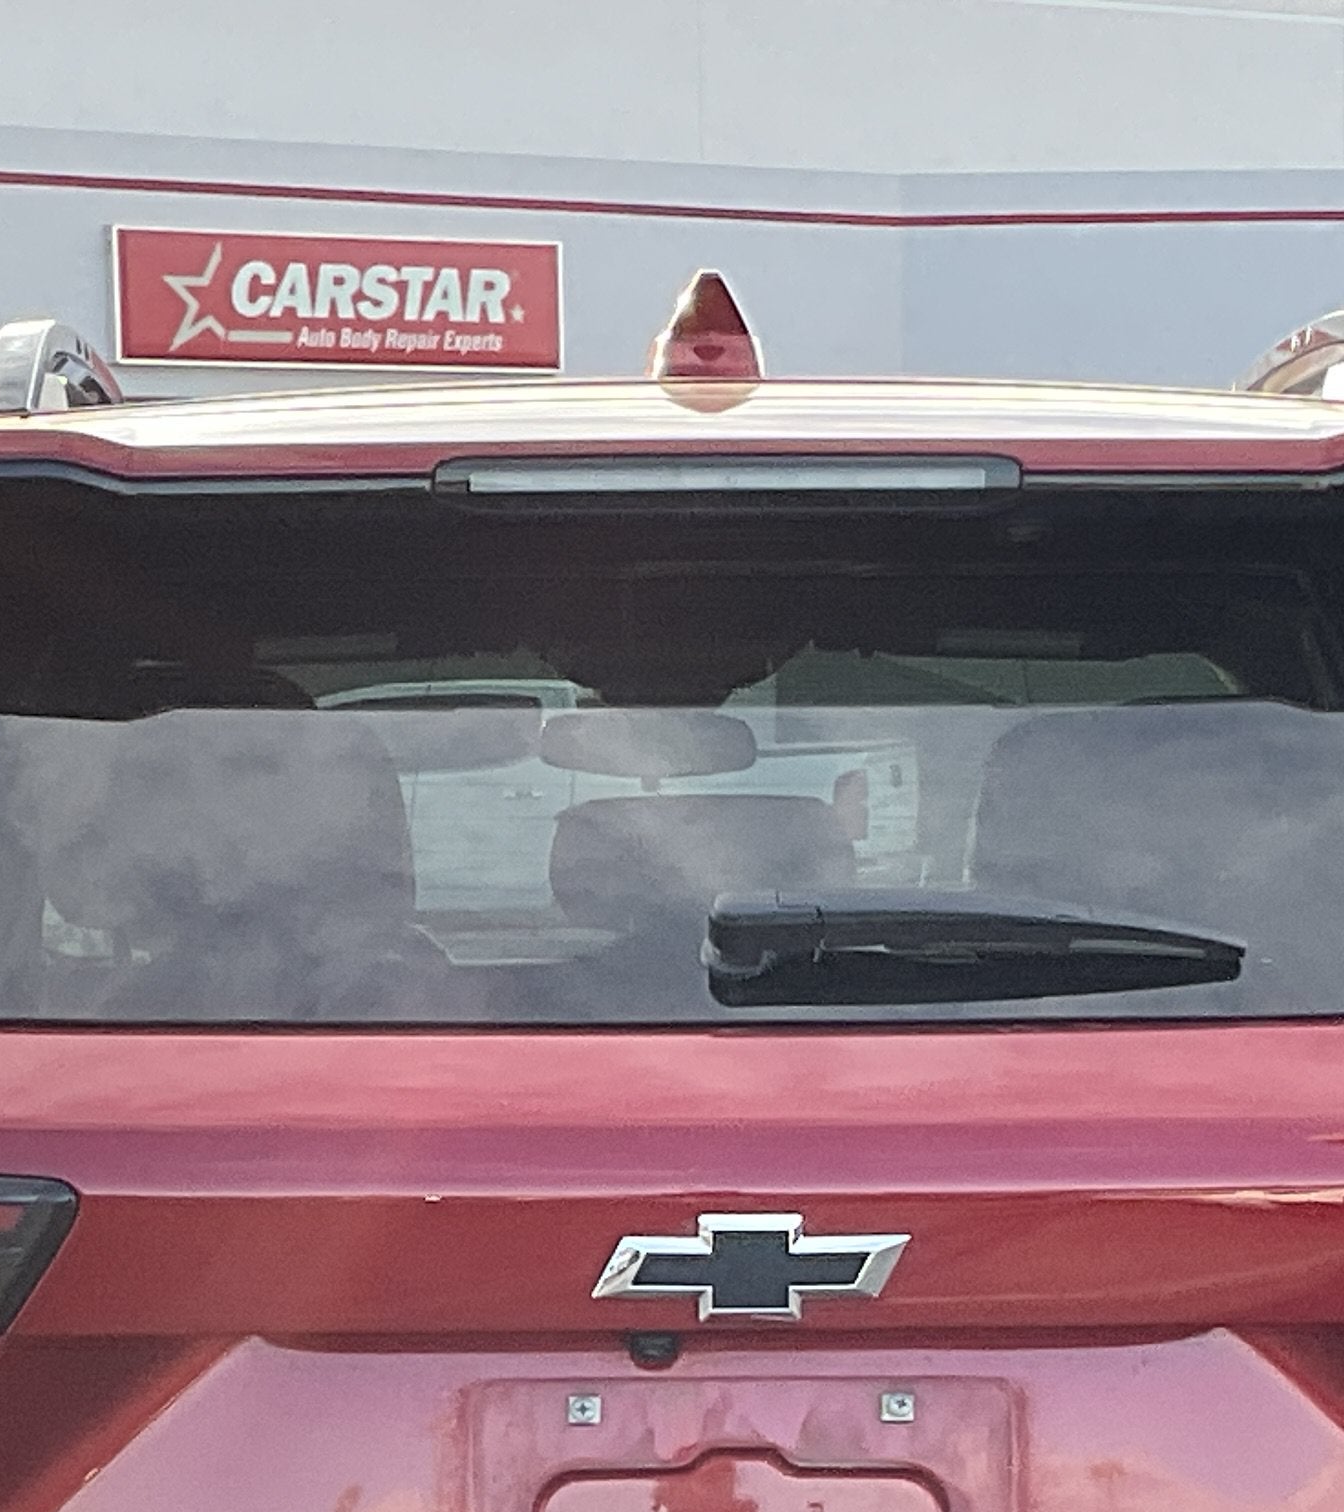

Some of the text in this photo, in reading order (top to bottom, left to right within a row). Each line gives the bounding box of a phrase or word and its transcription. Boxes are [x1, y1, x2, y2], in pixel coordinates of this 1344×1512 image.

[230, 260, 512, 325] CARSTAR
[297, 326, 504, 356] Auto Body Repair Experts
